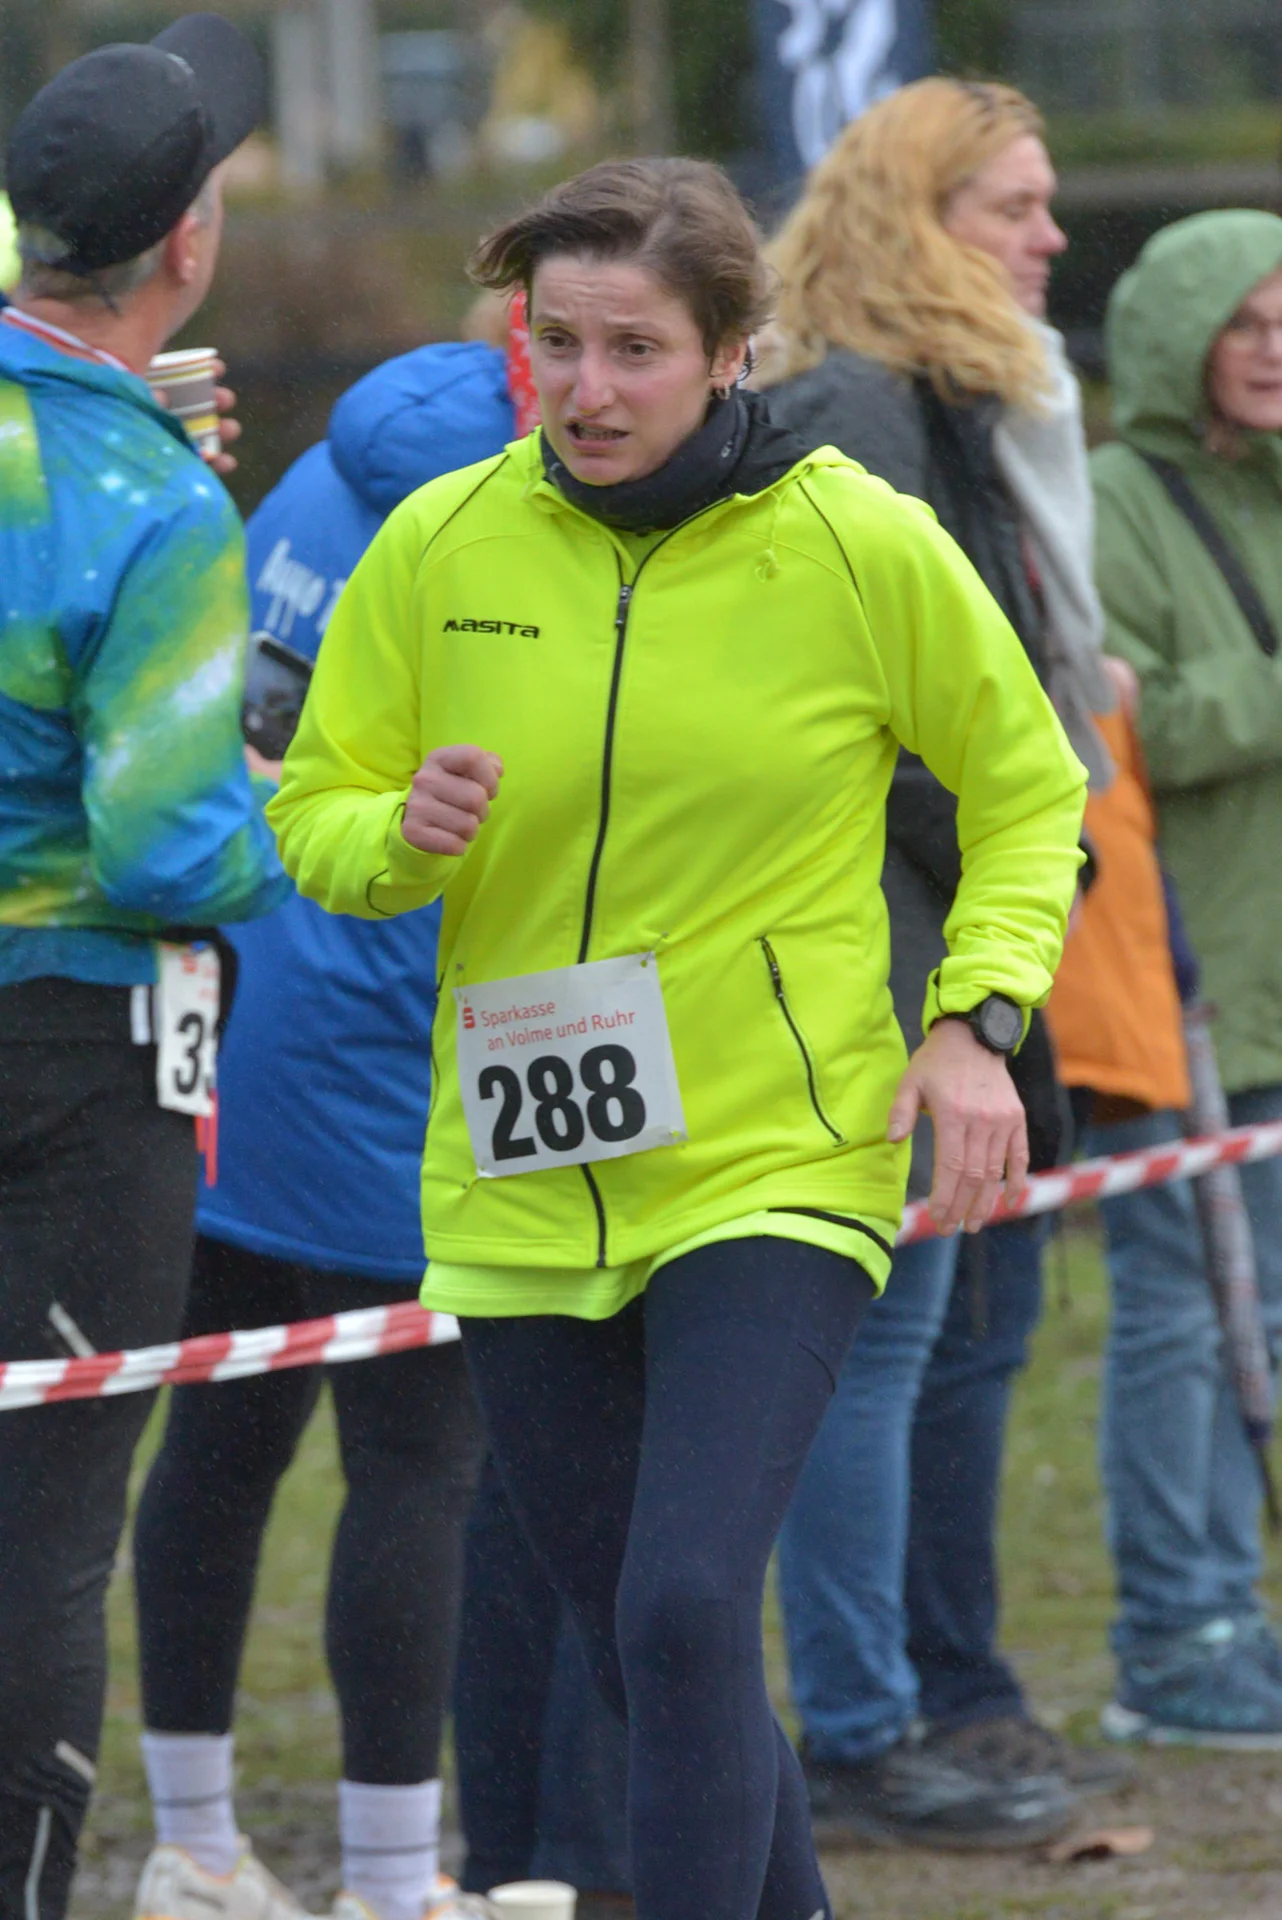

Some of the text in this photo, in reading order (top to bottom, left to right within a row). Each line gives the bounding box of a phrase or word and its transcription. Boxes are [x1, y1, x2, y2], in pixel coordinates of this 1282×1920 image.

[481, 1002, 556, 1028] Sparkasse
[487, 1010, 636, 1051] an Volme und Ruhr
[175, 1012, 215, 1097] 3
[478, 1043, 647, 1161] 288
